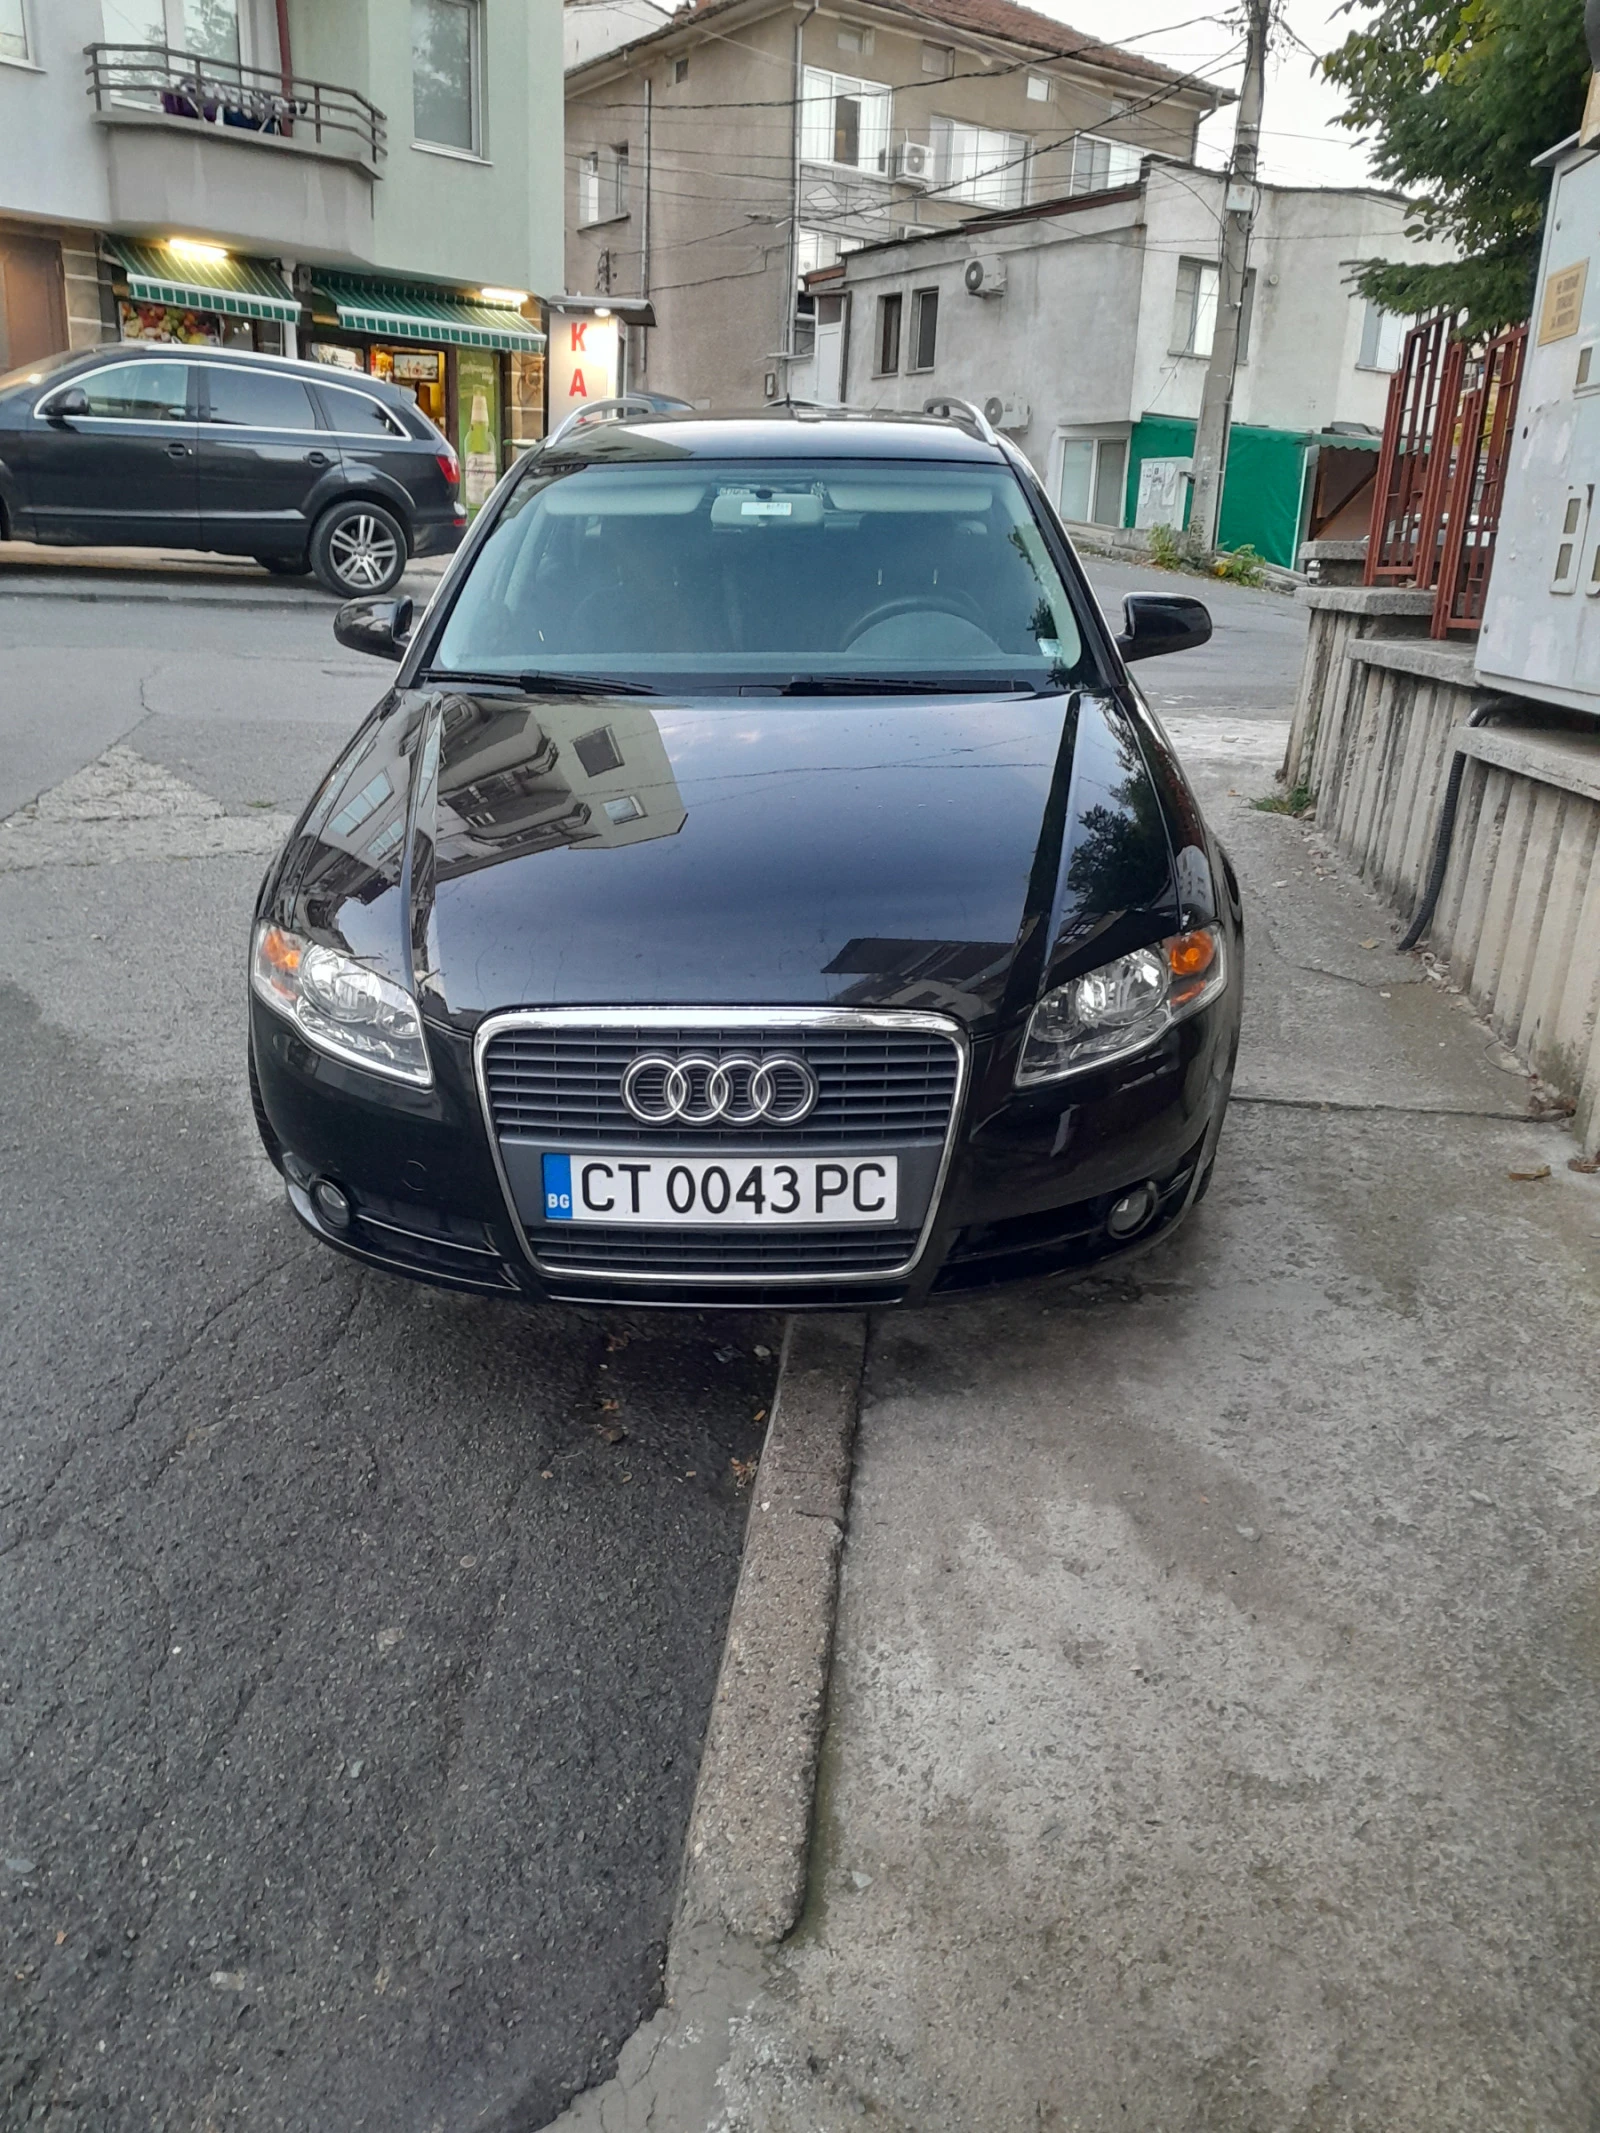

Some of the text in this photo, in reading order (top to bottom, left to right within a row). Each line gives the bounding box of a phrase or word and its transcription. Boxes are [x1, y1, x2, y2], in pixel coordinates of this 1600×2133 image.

[569, 322, 588, 423] КА
[548, 1193, 570, 1209] BG
[581, 1163, 886, 1214] CT 0043 PC
